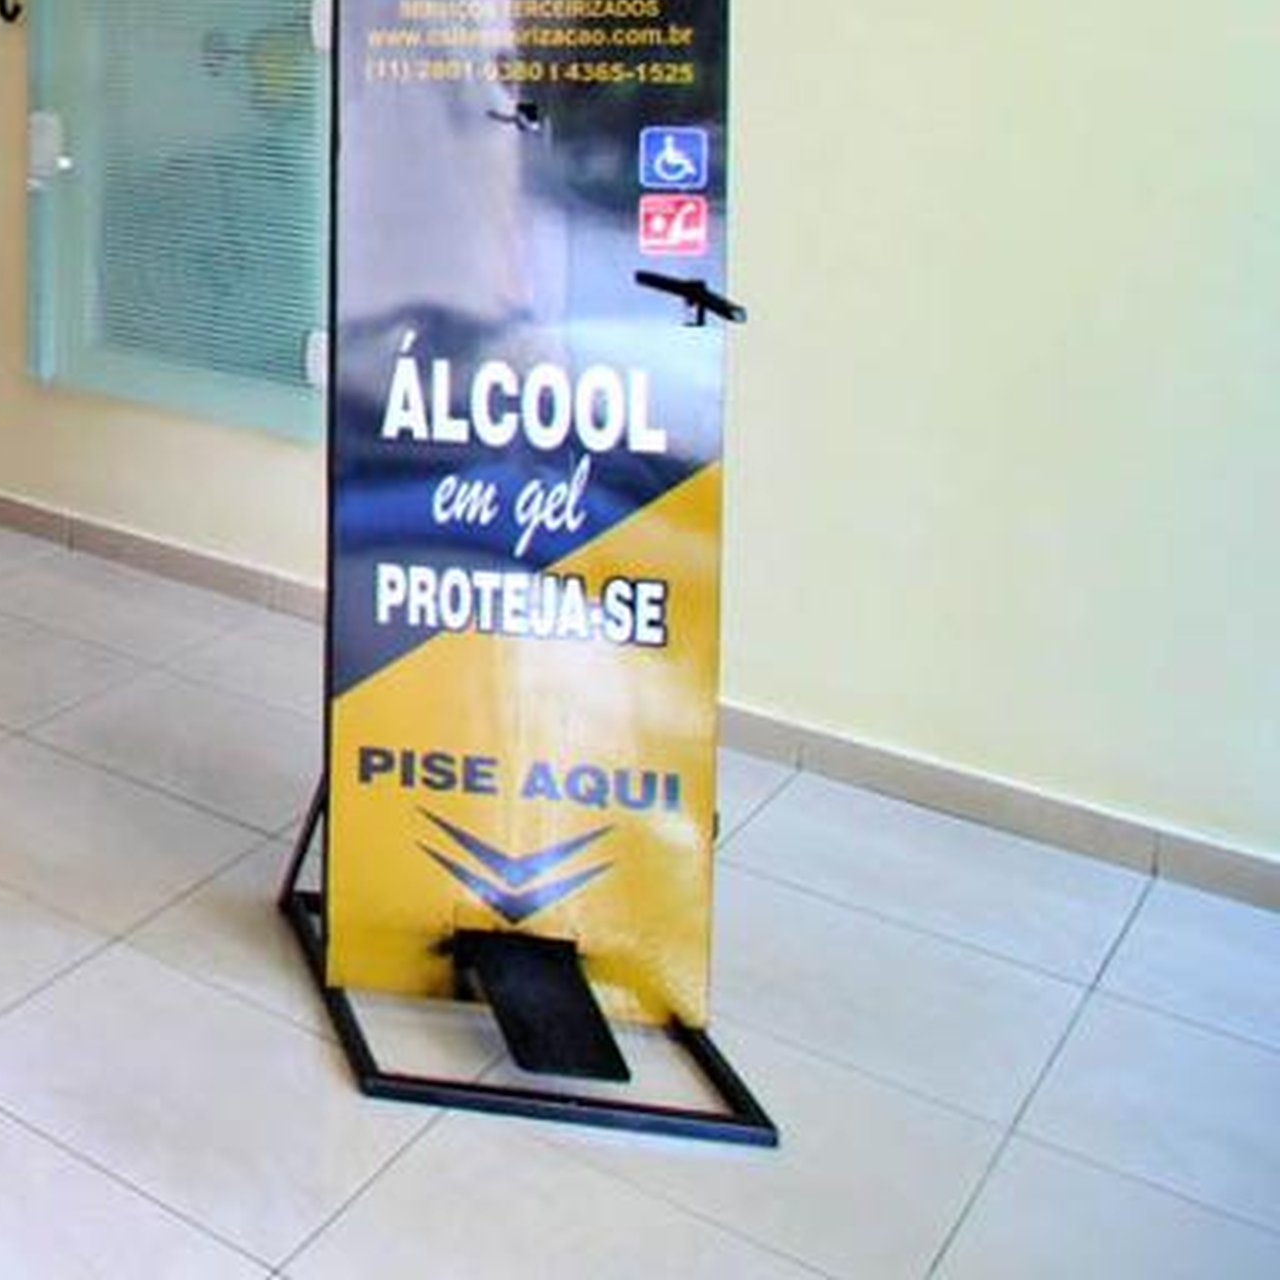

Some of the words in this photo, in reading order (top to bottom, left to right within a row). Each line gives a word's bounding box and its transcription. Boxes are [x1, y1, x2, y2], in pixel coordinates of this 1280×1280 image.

[563, 61, 695, 84] 4365-1525
[381, 330, 667, 453] ÁLCOOL
[431, 473, 500, 526] em
[513, 453, 591, 558] gel
[376, 562, 667, 645] PROTEJA-SE
[357, 745, 498, 794] PISE
[521, 760, 681, 812] AQUI
